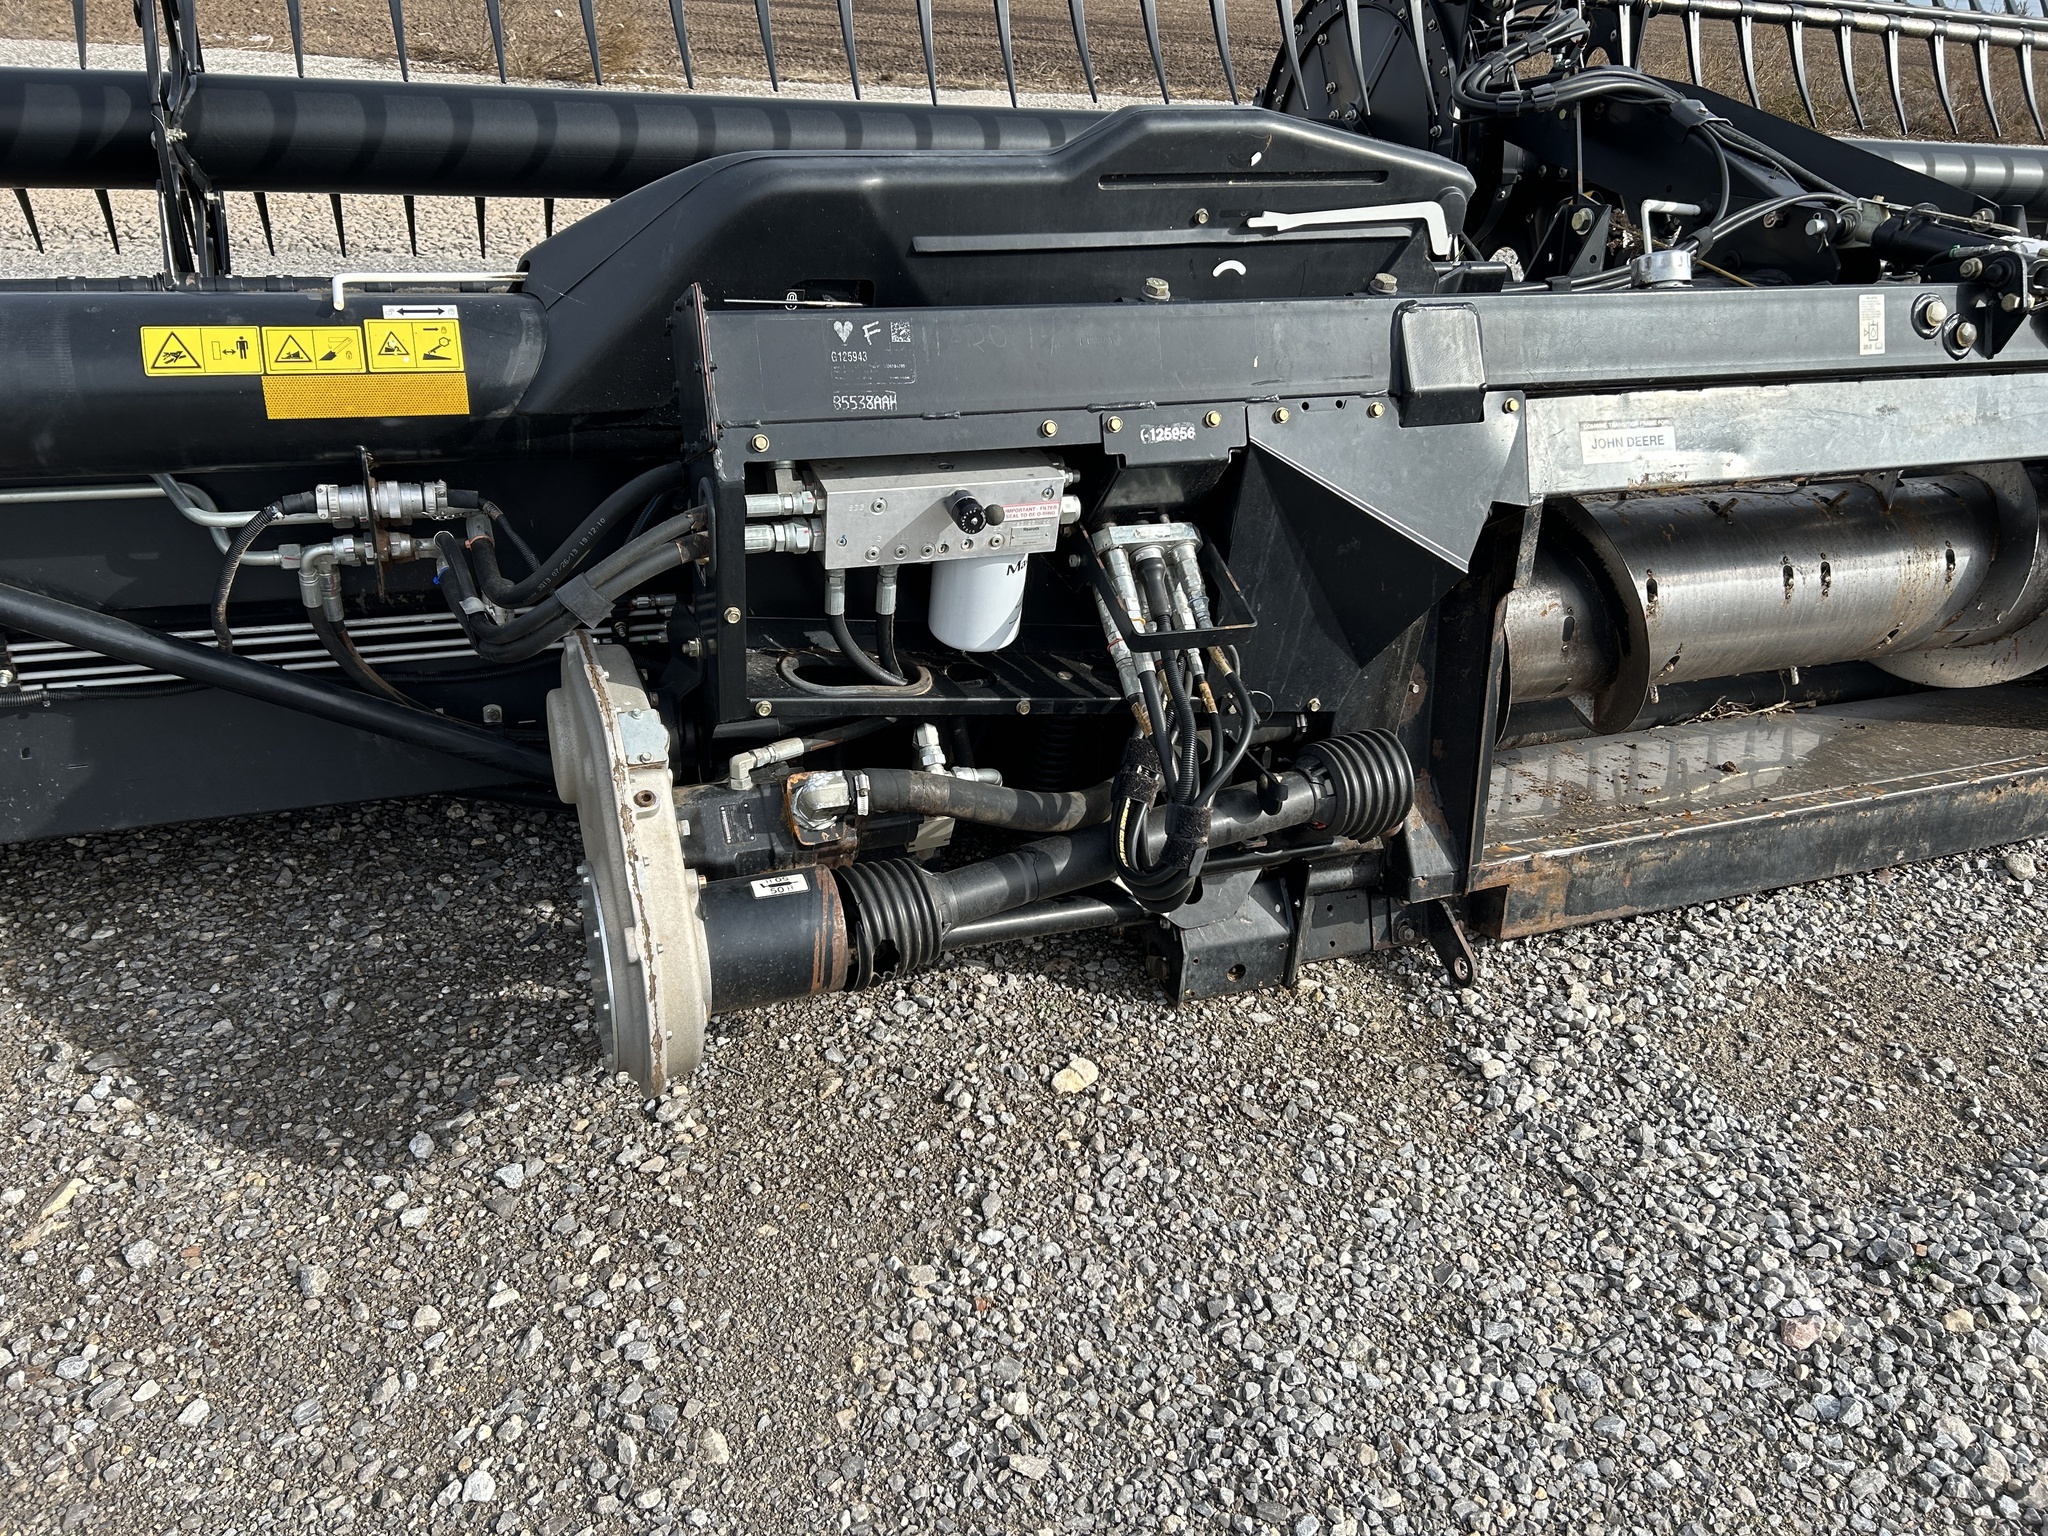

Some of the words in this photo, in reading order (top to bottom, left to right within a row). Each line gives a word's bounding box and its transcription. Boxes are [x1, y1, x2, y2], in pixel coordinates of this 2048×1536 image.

[862, 320, 881, 345] F
[830, 351, 868, 362] G125943
[1592, 438, 1624, 449] JOHN
[1627, 435, 1664, 447] DEERE
[770, 886, 785, 895] 50
